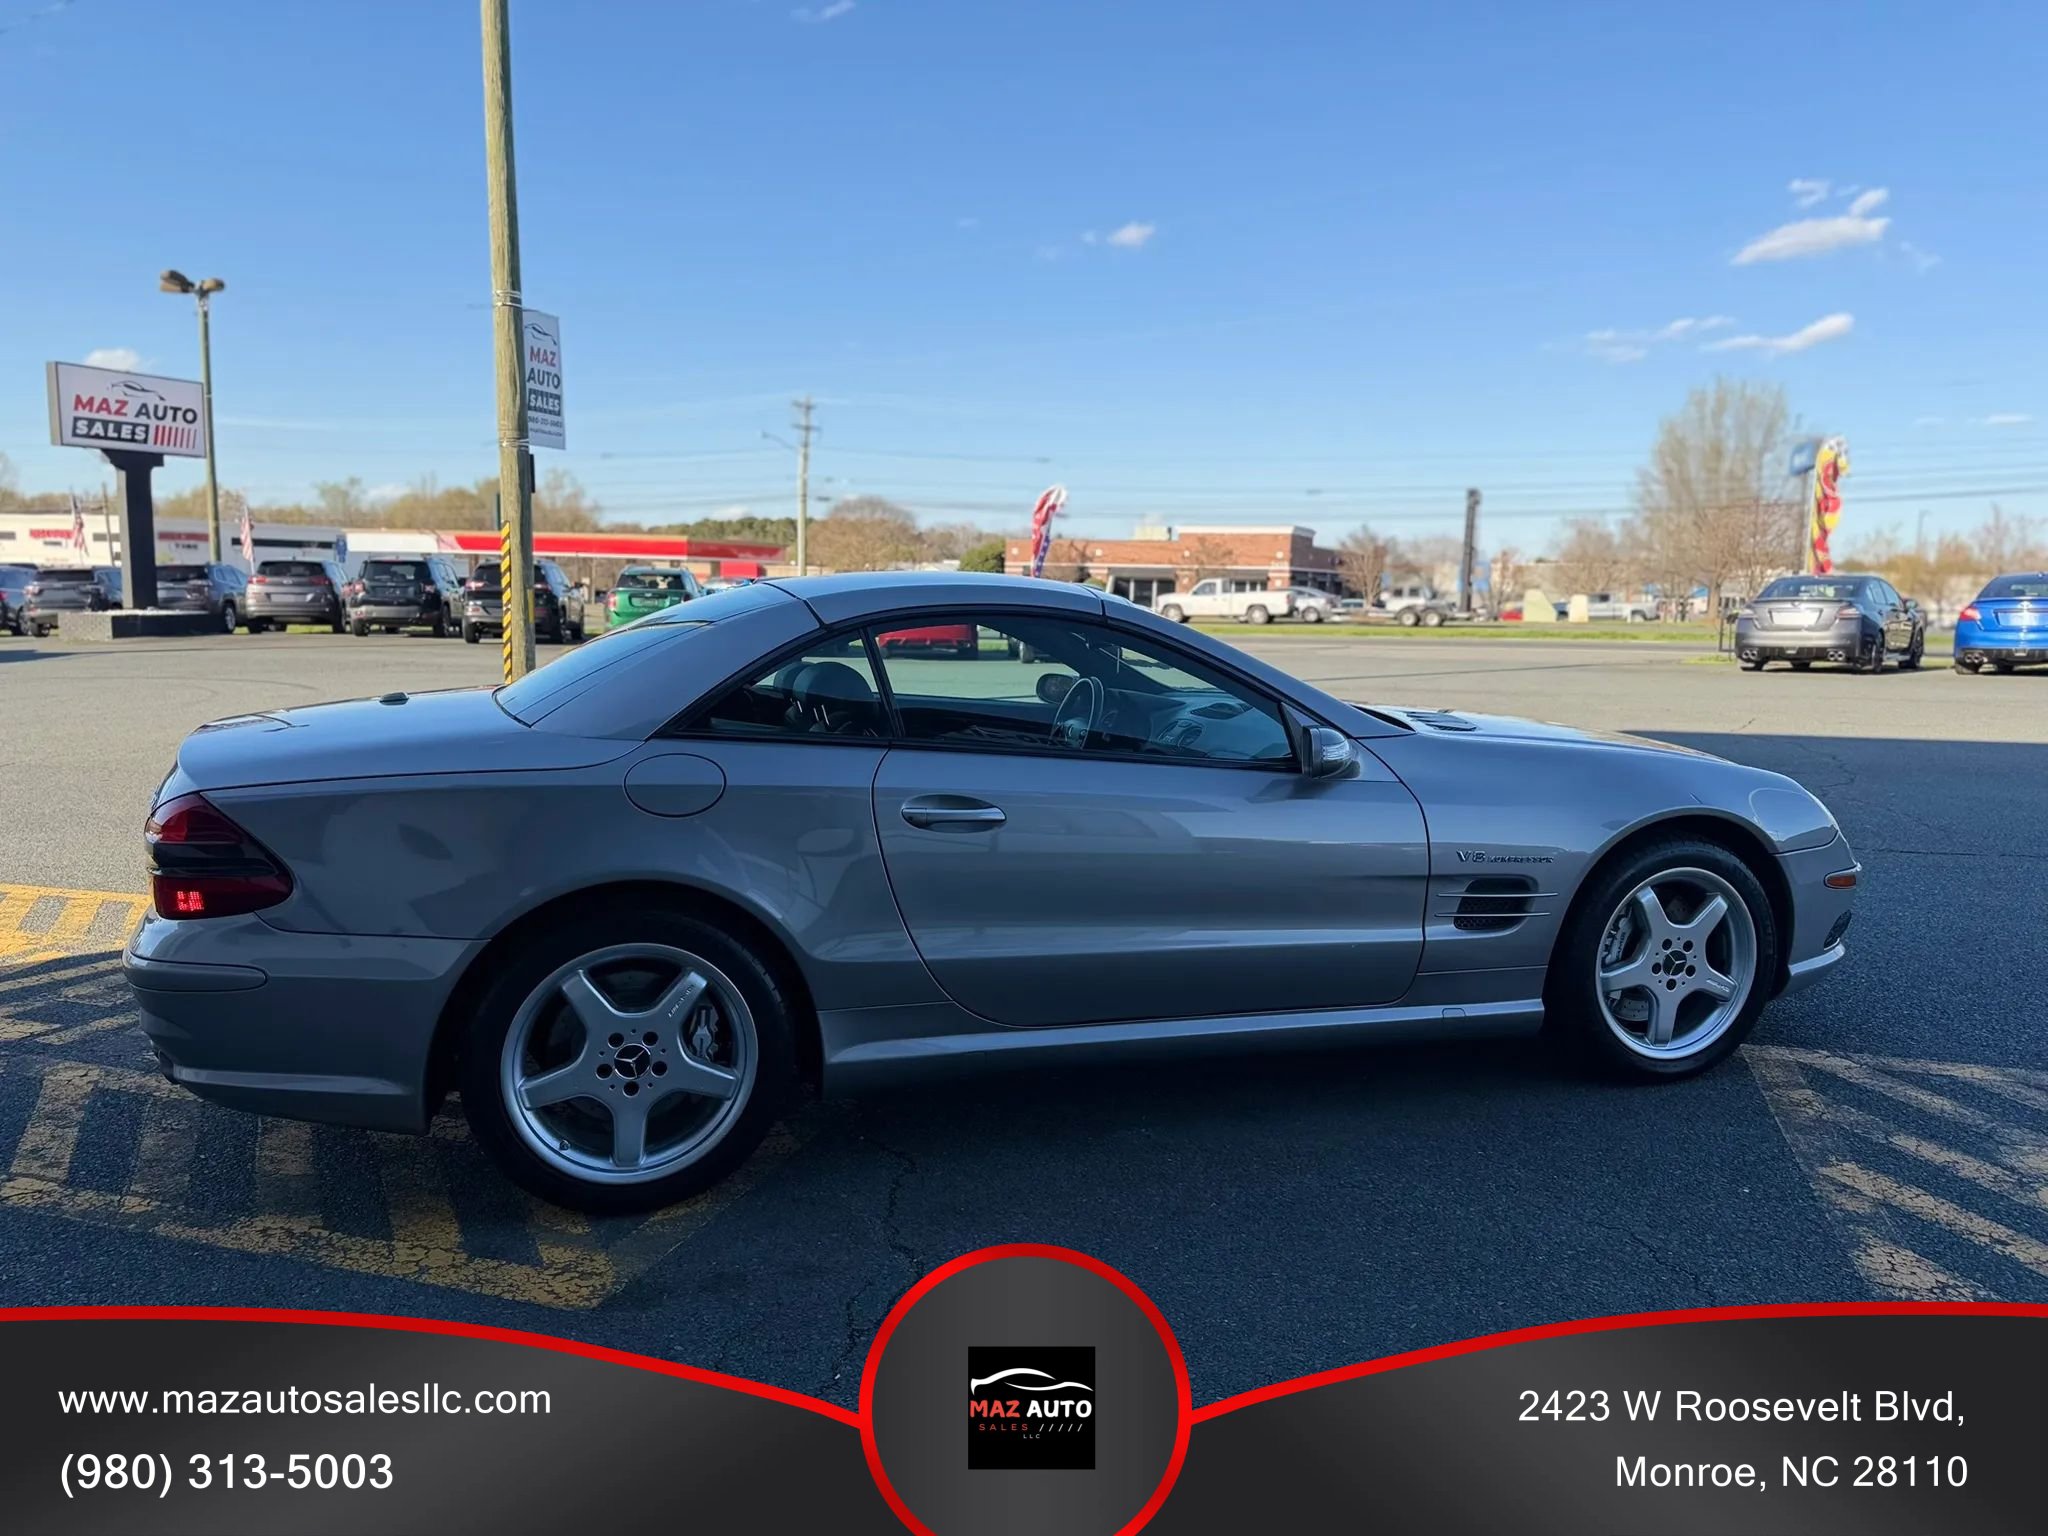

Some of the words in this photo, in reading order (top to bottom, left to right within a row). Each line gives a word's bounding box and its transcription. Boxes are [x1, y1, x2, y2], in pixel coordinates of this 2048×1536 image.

[529, 345, 557, 368] MAZ
[527, 367, 561, 390] AUTO
[73, 394, 129, 417] MAZ
[134, 402, 198, 424] AUTO
[529, 394, 560, 412] SALES
[75, 419, 148, 441] SALES
[1456, 850, 1486, 863] V8
